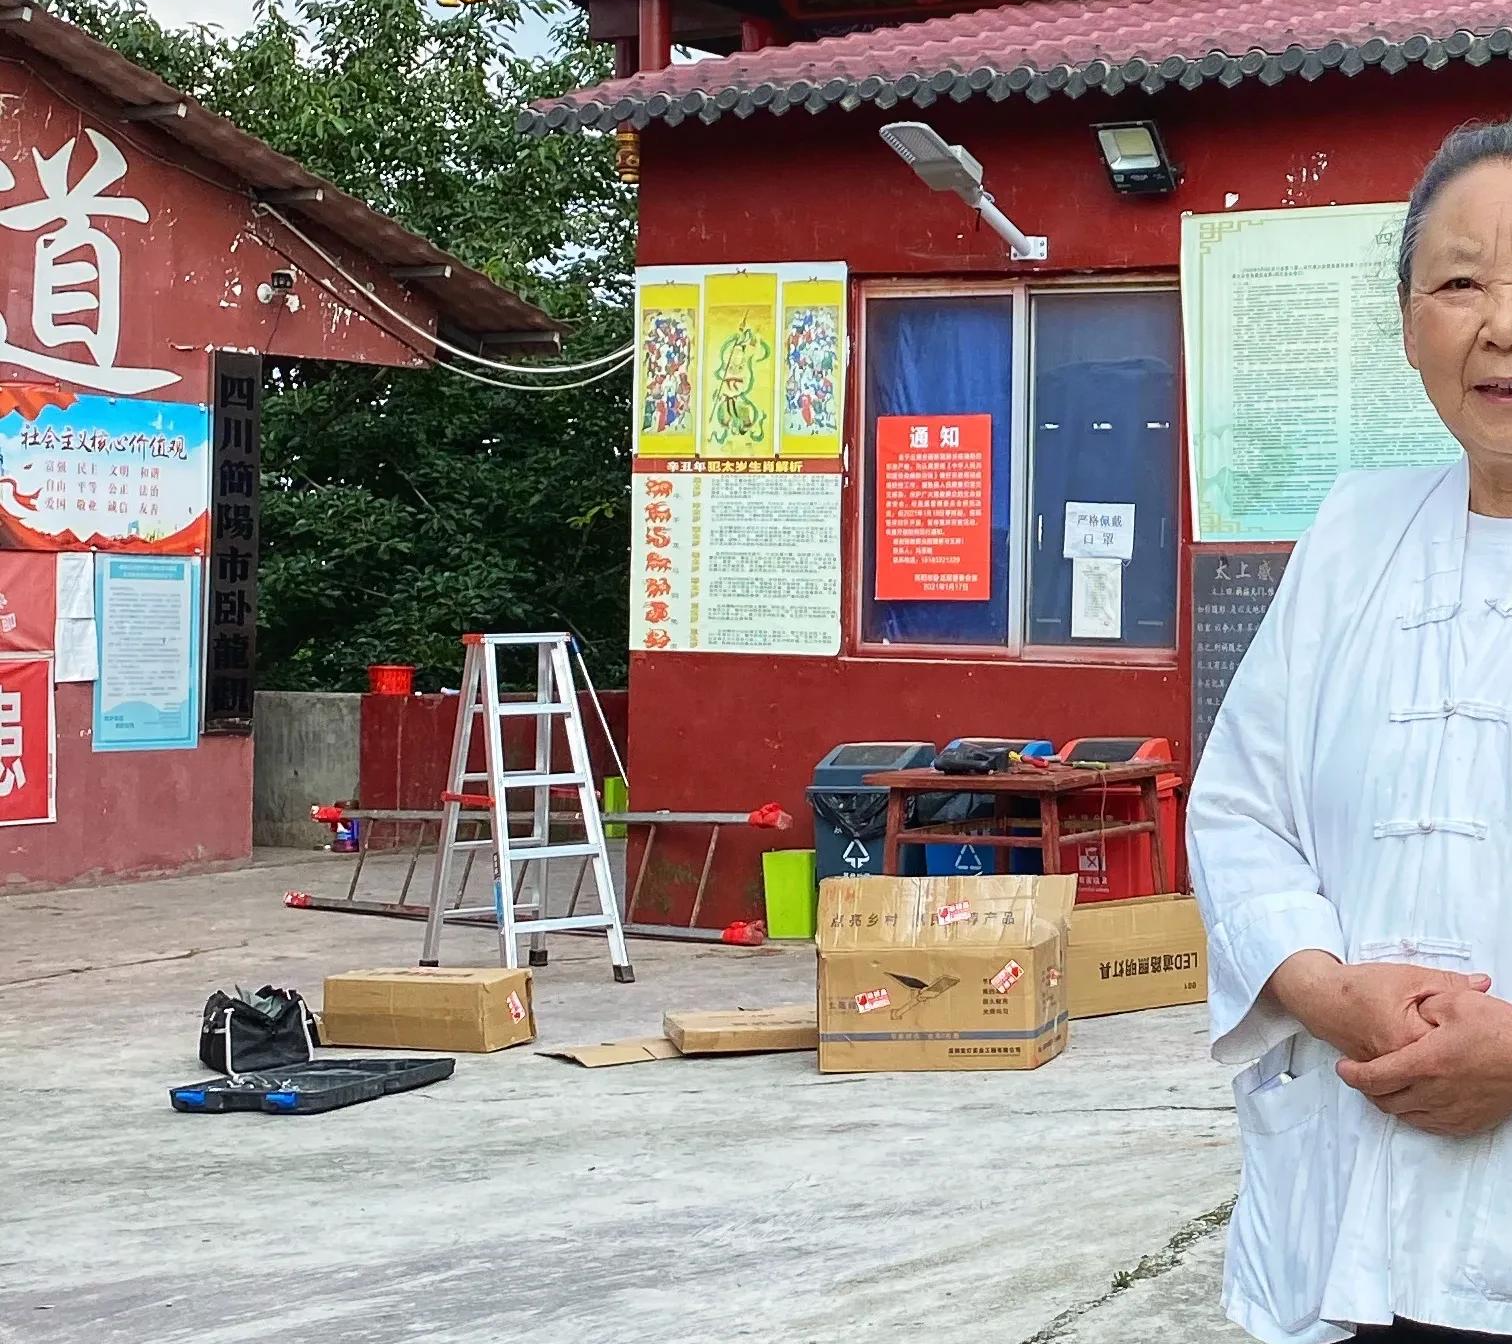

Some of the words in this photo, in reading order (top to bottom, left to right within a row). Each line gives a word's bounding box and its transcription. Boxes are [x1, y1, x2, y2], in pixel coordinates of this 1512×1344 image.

[0, 128, 183, 395] 道
[20, 424, 188, 462] 社会主义核心价值观
[909, 425, 960, 449] 通知
[1077, 514, 1123, 528] 严格佩戴
[1083, 532, 1114, 547] 口罩
[1099, 952, 1199, 980] LED道路照明灯具
